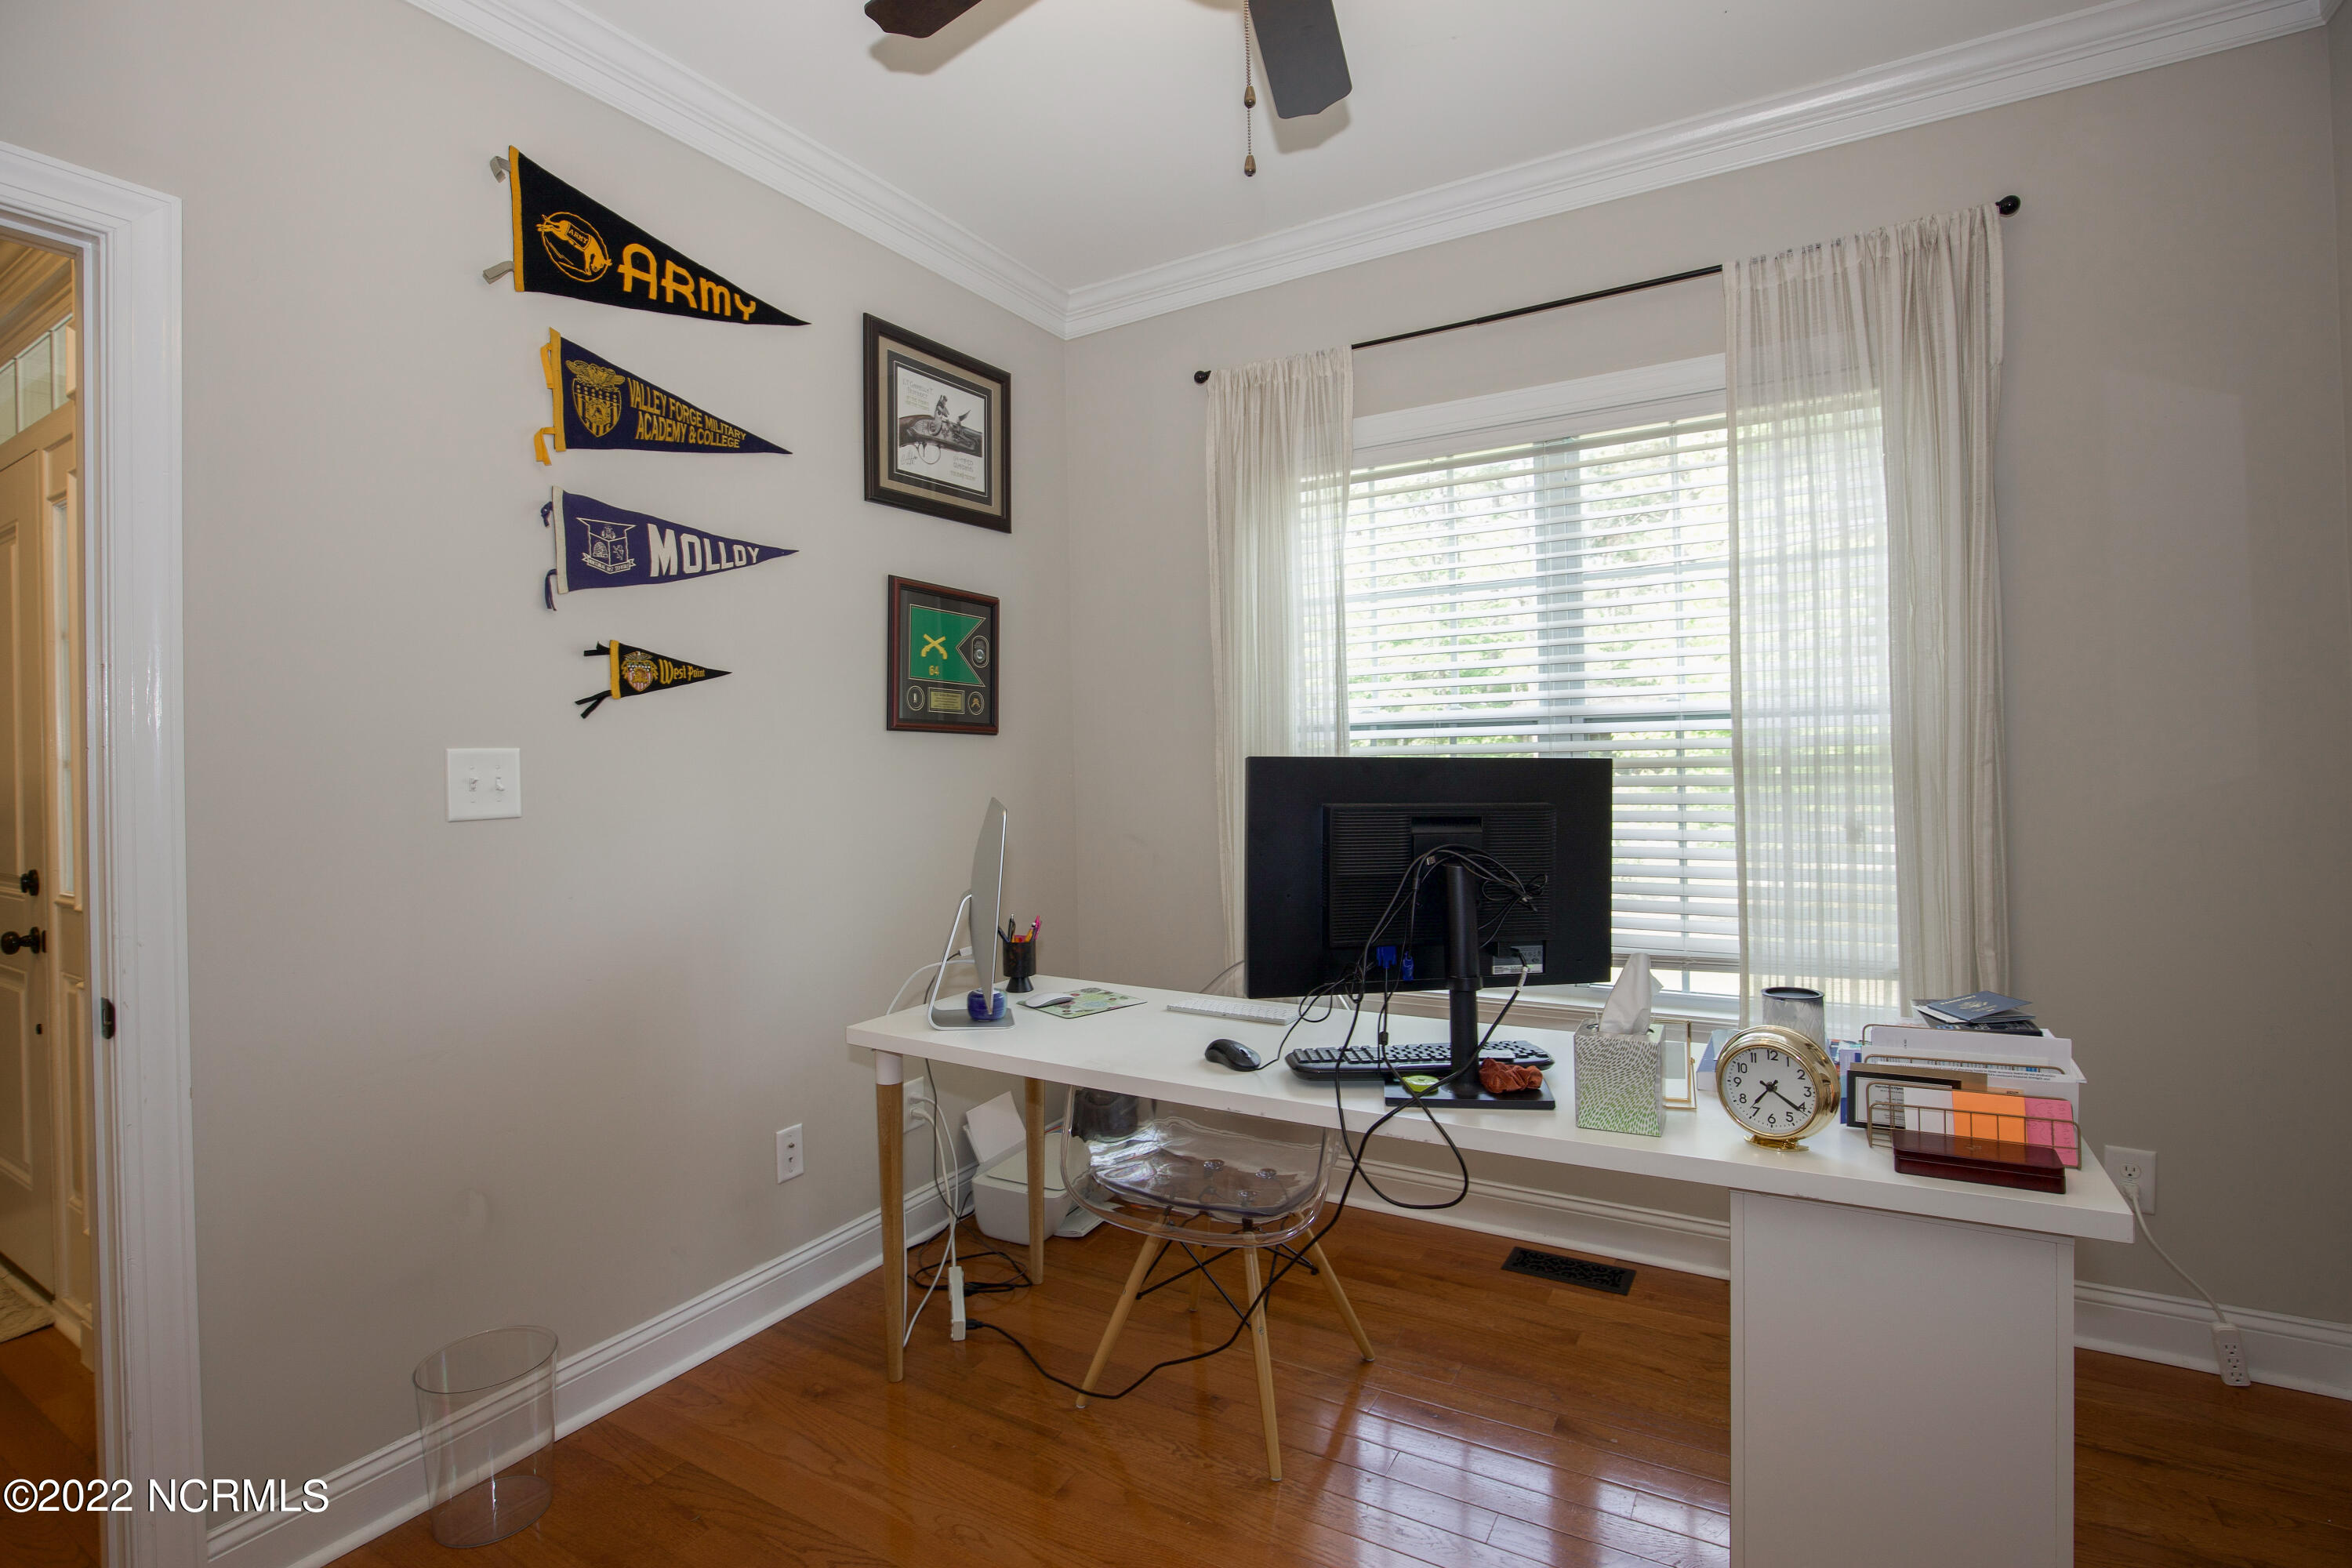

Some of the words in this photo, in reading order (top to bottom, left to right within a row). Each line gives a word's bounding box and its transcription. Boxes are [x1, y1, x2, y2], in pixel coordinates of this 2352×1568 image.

[568, 229, 588, 244] ARMY
[618, 243, 757, 321] ARMY
[627, 377, 666, 417] VALLEY
[668, 397, 703, 427] FORGE
[704, 415, 746, 441] MILITARY
[634, 411, 688, 443] ACADEMY
[696, 428, 740, 448] COLLEGE
[647, 523, 760, 577] MOLLOY
[659, 659, 686, 684] West
[687, 665, 706, 681] Point
[929, 665, 939, 676] 64
[1750, 1052, 1757, 1063] 11
[1766, 1049, 1779, 1061] 12
[1786, 1056, 1790, 1067] 1
[1737, 1062, 1748, 1073] 10
[1796, 1069, 1806, 1080] 2
[1733, 1076, 1742, 1087] 9
[1803, 1086, 1812, 1097] 3
[1739, 1094, 1747, 1104] 8
[1752, 1106, 1761, 1117] 7
[1798, 1102, 1806, 1112] 4
[1767, 1113, 1776, 1124] 6
[1786, 1111, 1794, 1122] 5
